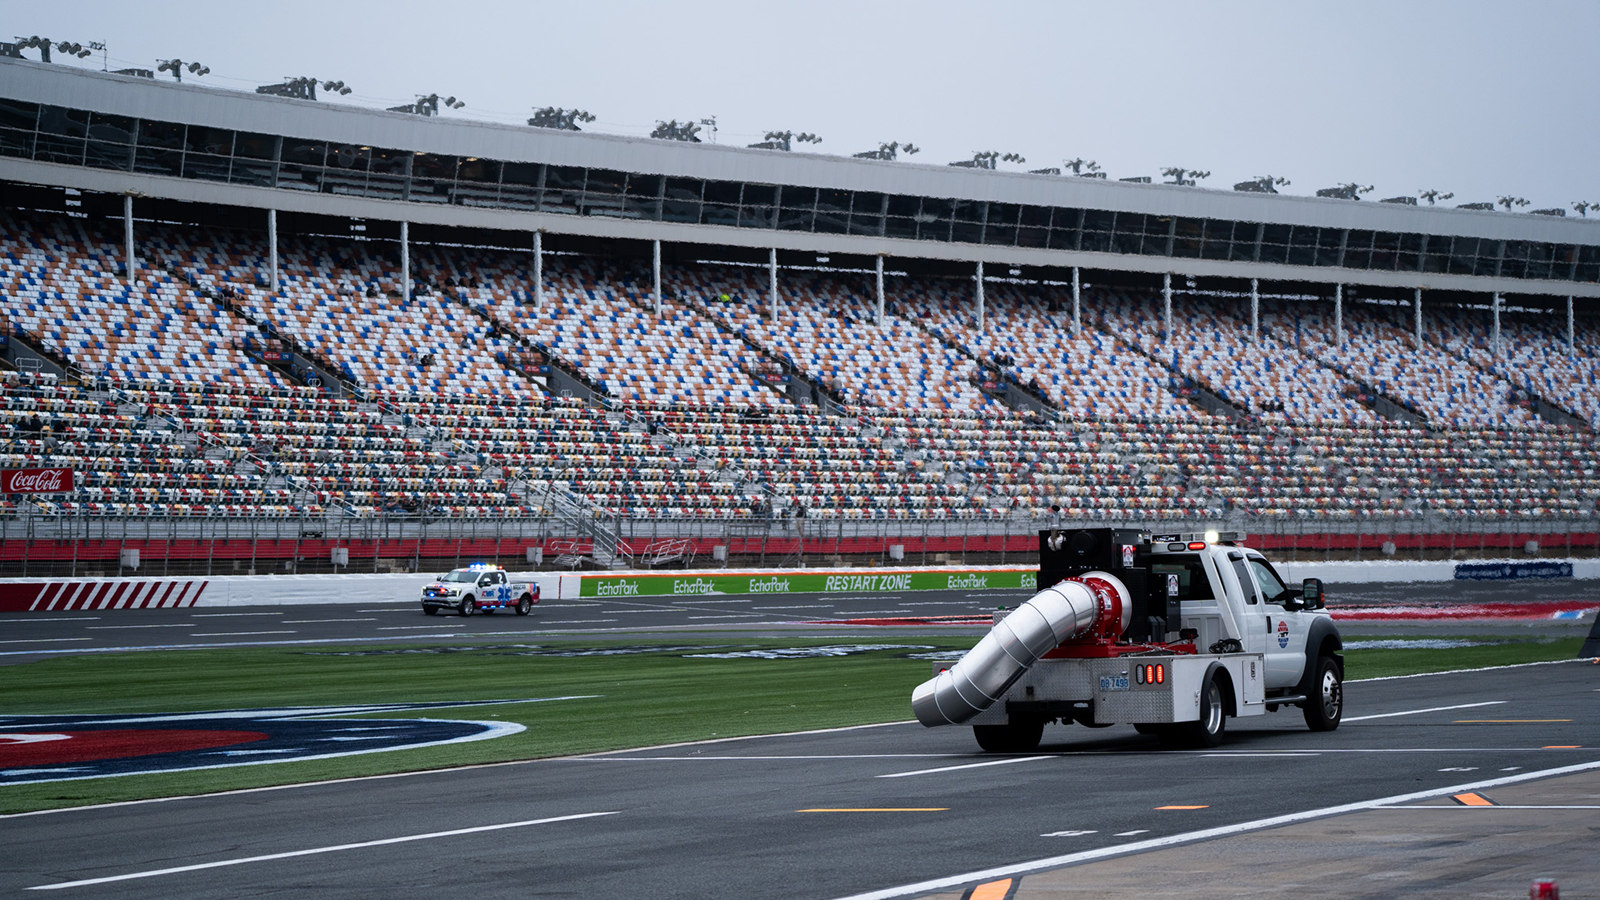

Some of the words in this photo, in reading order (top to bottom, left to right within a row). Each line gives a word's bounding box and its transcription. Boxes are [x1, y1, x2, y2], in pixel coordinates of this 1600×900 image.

[10, 469, 64, 491] Coca-Cola
[597, 579, 639, 596] EchoPark
[673, 578, 716, 594] EchoPark
[749, 576, 790, 593] EchoPark
[825, 575, 878, 591] RESTART
[879, 574, 912, 590] ZONE
[947, 574, 988, 588] EchoPark
